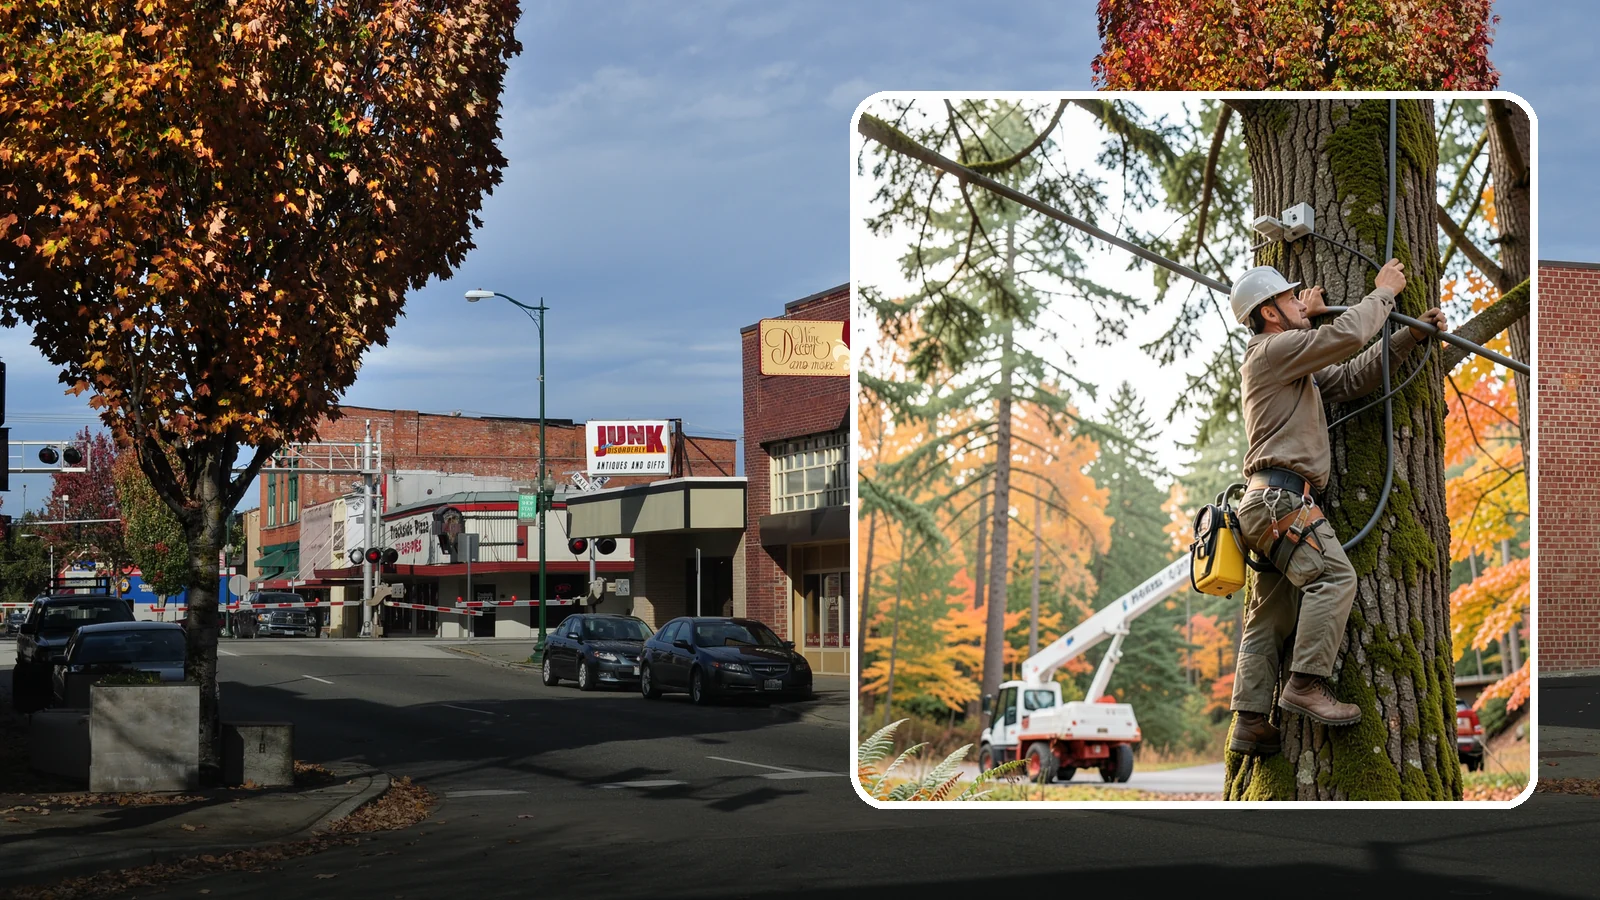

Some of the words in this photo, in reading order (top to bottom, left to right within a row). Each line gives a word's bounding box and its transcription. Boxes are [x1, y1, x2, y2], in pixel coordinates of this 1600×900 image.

[595, 425, 665, 457] JUNK
[607, 446, 646, 454] DISORDERLY
[597, 461, 628, 470] ANTIQUES
[631, 461, 644, 470] AND
[647, 460, 665, 469] GIFTS
[589, 476, 608, 492] SING
[390, 521, 413, 539] Trackside
[415, 520, 429, 535] Pizza
